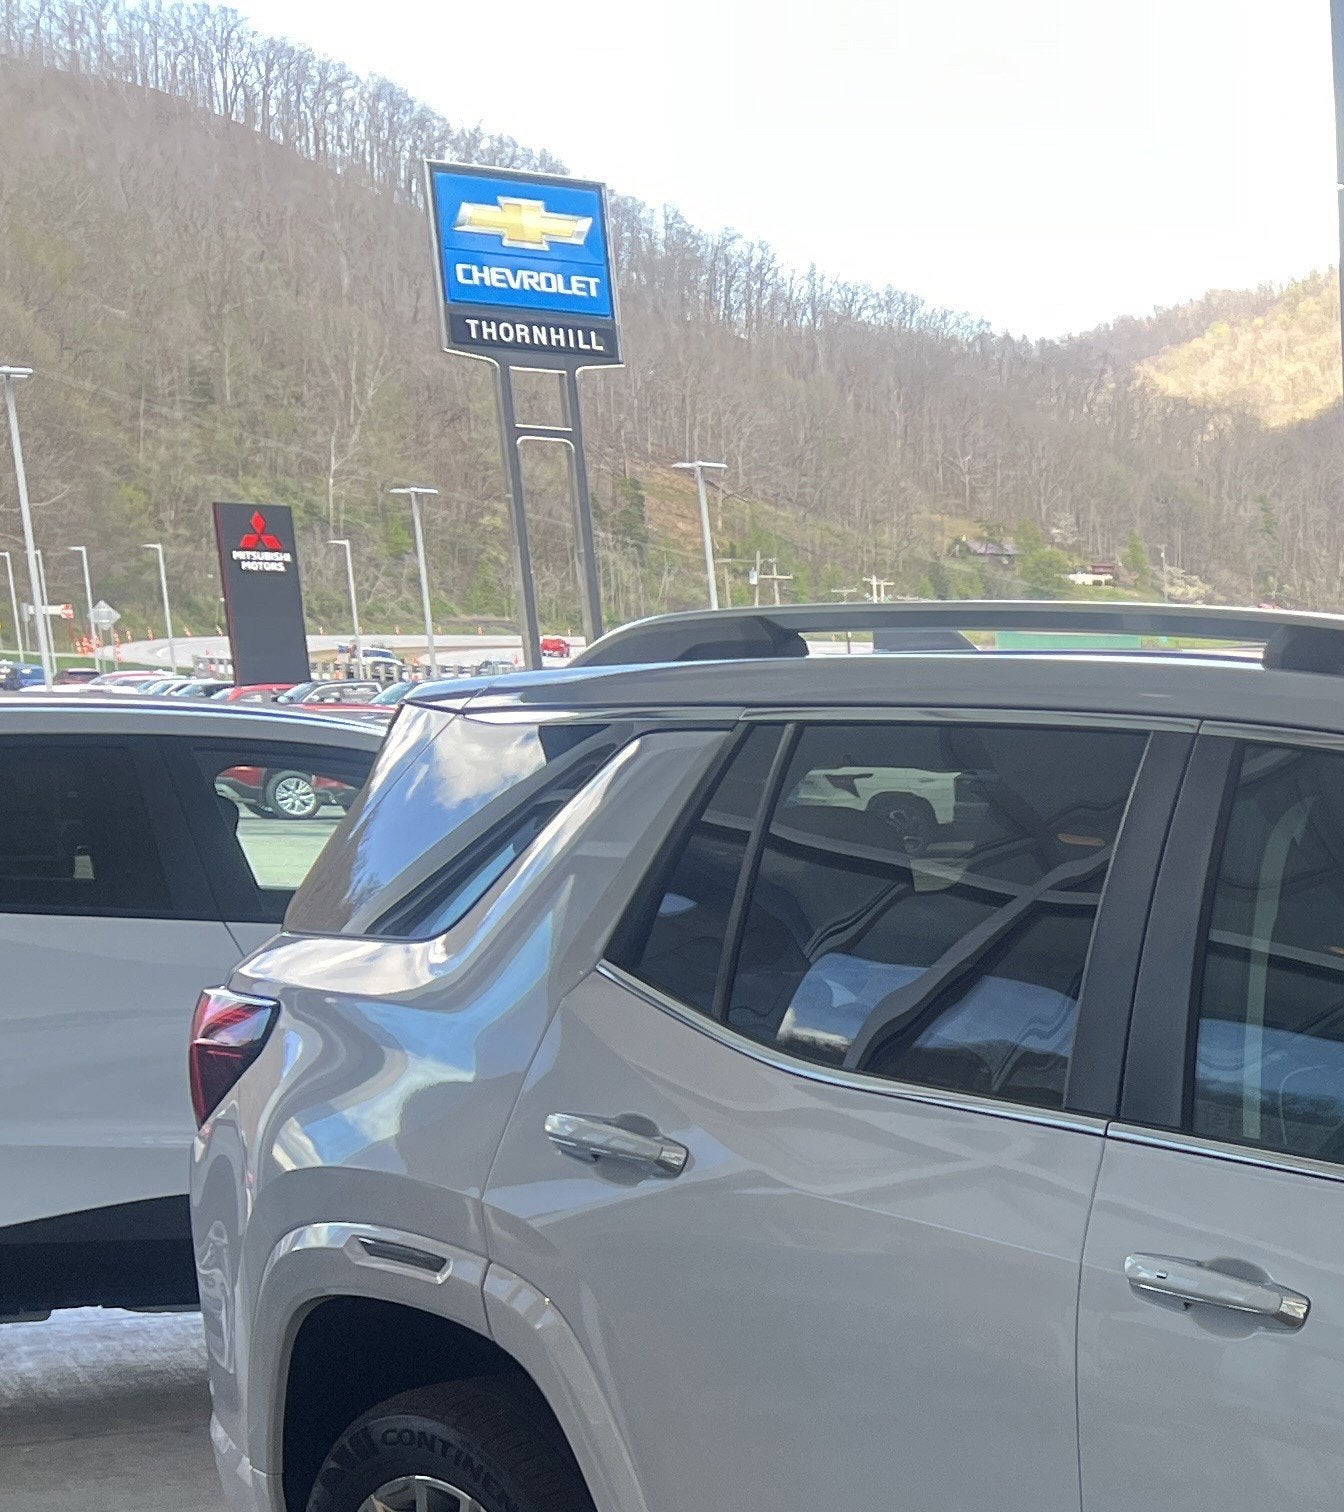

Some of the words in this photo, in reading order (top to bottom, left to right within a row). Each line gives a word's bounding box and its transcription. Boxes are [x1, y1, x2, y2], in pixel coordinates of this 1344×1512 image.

[455, 263, 600, 297] CHEVROLET
[465, 318, 605, 351] THORNHILL
[232, 550, 291, 562] MITSUBISHI
[240, 560, 286, 572] MOTORS
